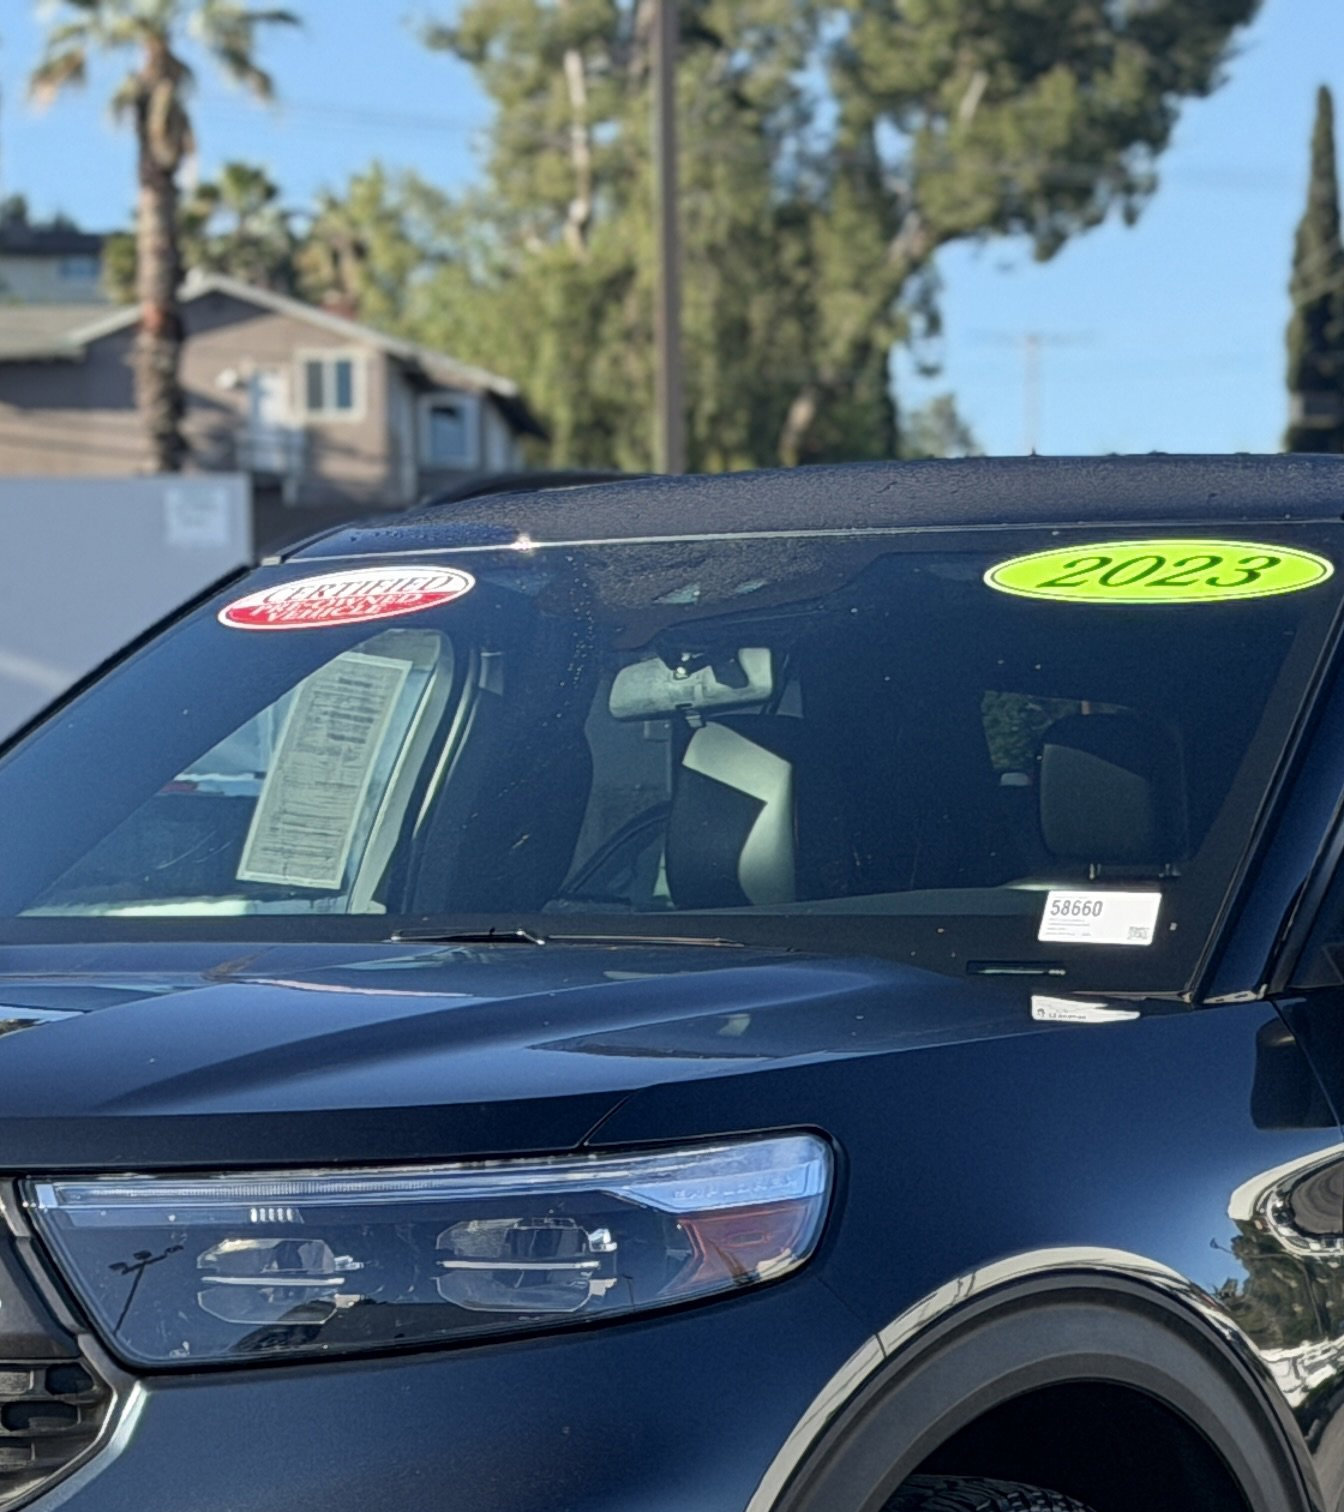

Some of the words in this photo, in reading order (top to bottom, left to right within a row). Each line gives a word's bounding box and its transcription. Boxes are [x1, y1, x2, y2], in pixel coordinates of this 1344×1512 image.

[1035, 555, 1282, 589] 2023
[262, 575, 453, 604] CERTIFIED
[267, 602, 387, 622] VEHICLE
[1050, 899, 1103, 917] 58660
